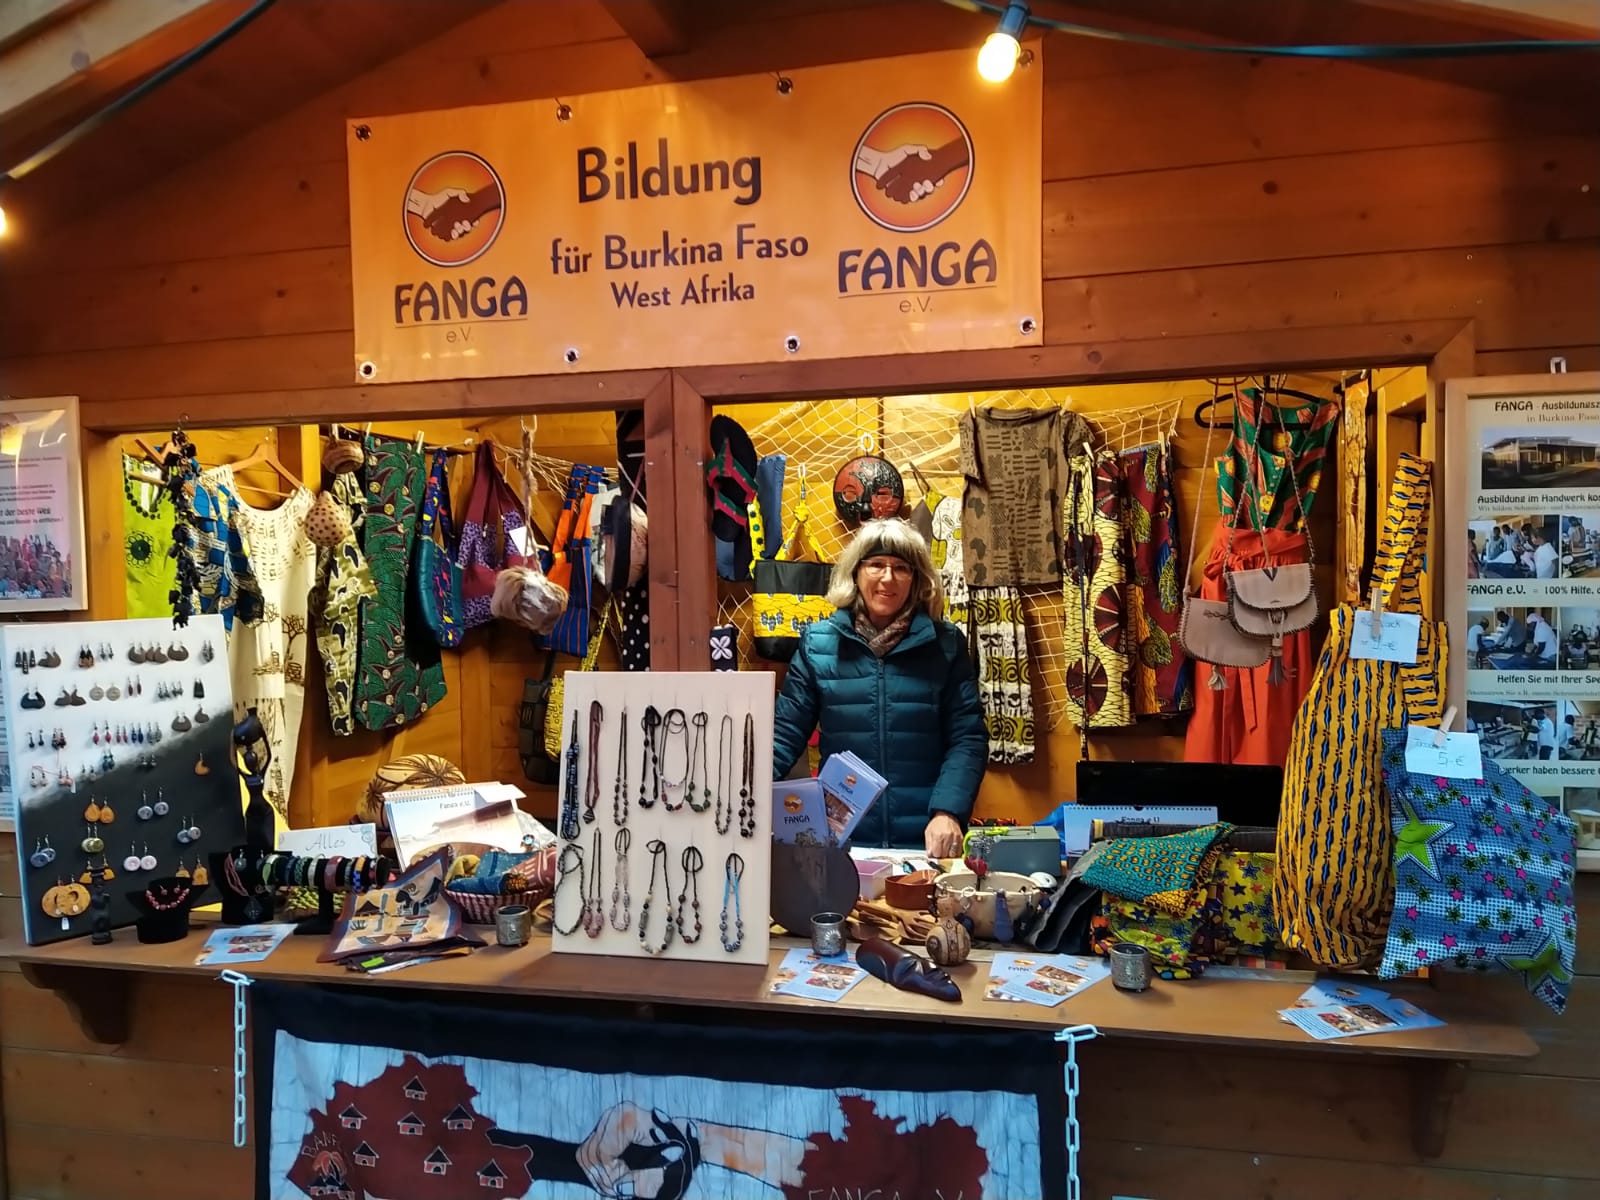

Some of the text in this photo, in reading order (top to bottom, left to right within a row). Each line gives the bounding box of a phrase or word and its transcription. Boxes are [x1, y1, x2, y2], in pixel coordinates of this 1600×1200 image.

[577, 137, 762, 206] Bildung
[551, 223, 809, 275] für Burkina Faso
[838, 238, 997, 293] FANGA
[394, 275, 528, 324] FANGA
[610, 272, 755, 309] West Afrika
[899, 295, 933, 313] e.V.
[1495, 401, 1534, 412] FANGA
[1477, 494, 1526, 504] Ausbildung
[1527, 494, 1539, 503] im
[1541, 494, 1586, 503] Handwerk
[1506, 584, 1526, 595] e.V.
[1545, 585, 1568, 595] 100%
[1497, 674, 1526, 684] Helfen
[1527, 674, 1541, 684] Sie
[1543, 674, 1558, 684] mit
[1561, 674, 1582, 684] Ihrer
[1532, 765, 1559, 775] haben
[1561, 765, 1596, 775] bessere
[784, 815, 810, 825] FANGA
[305, 832, 346, 851] Alles
